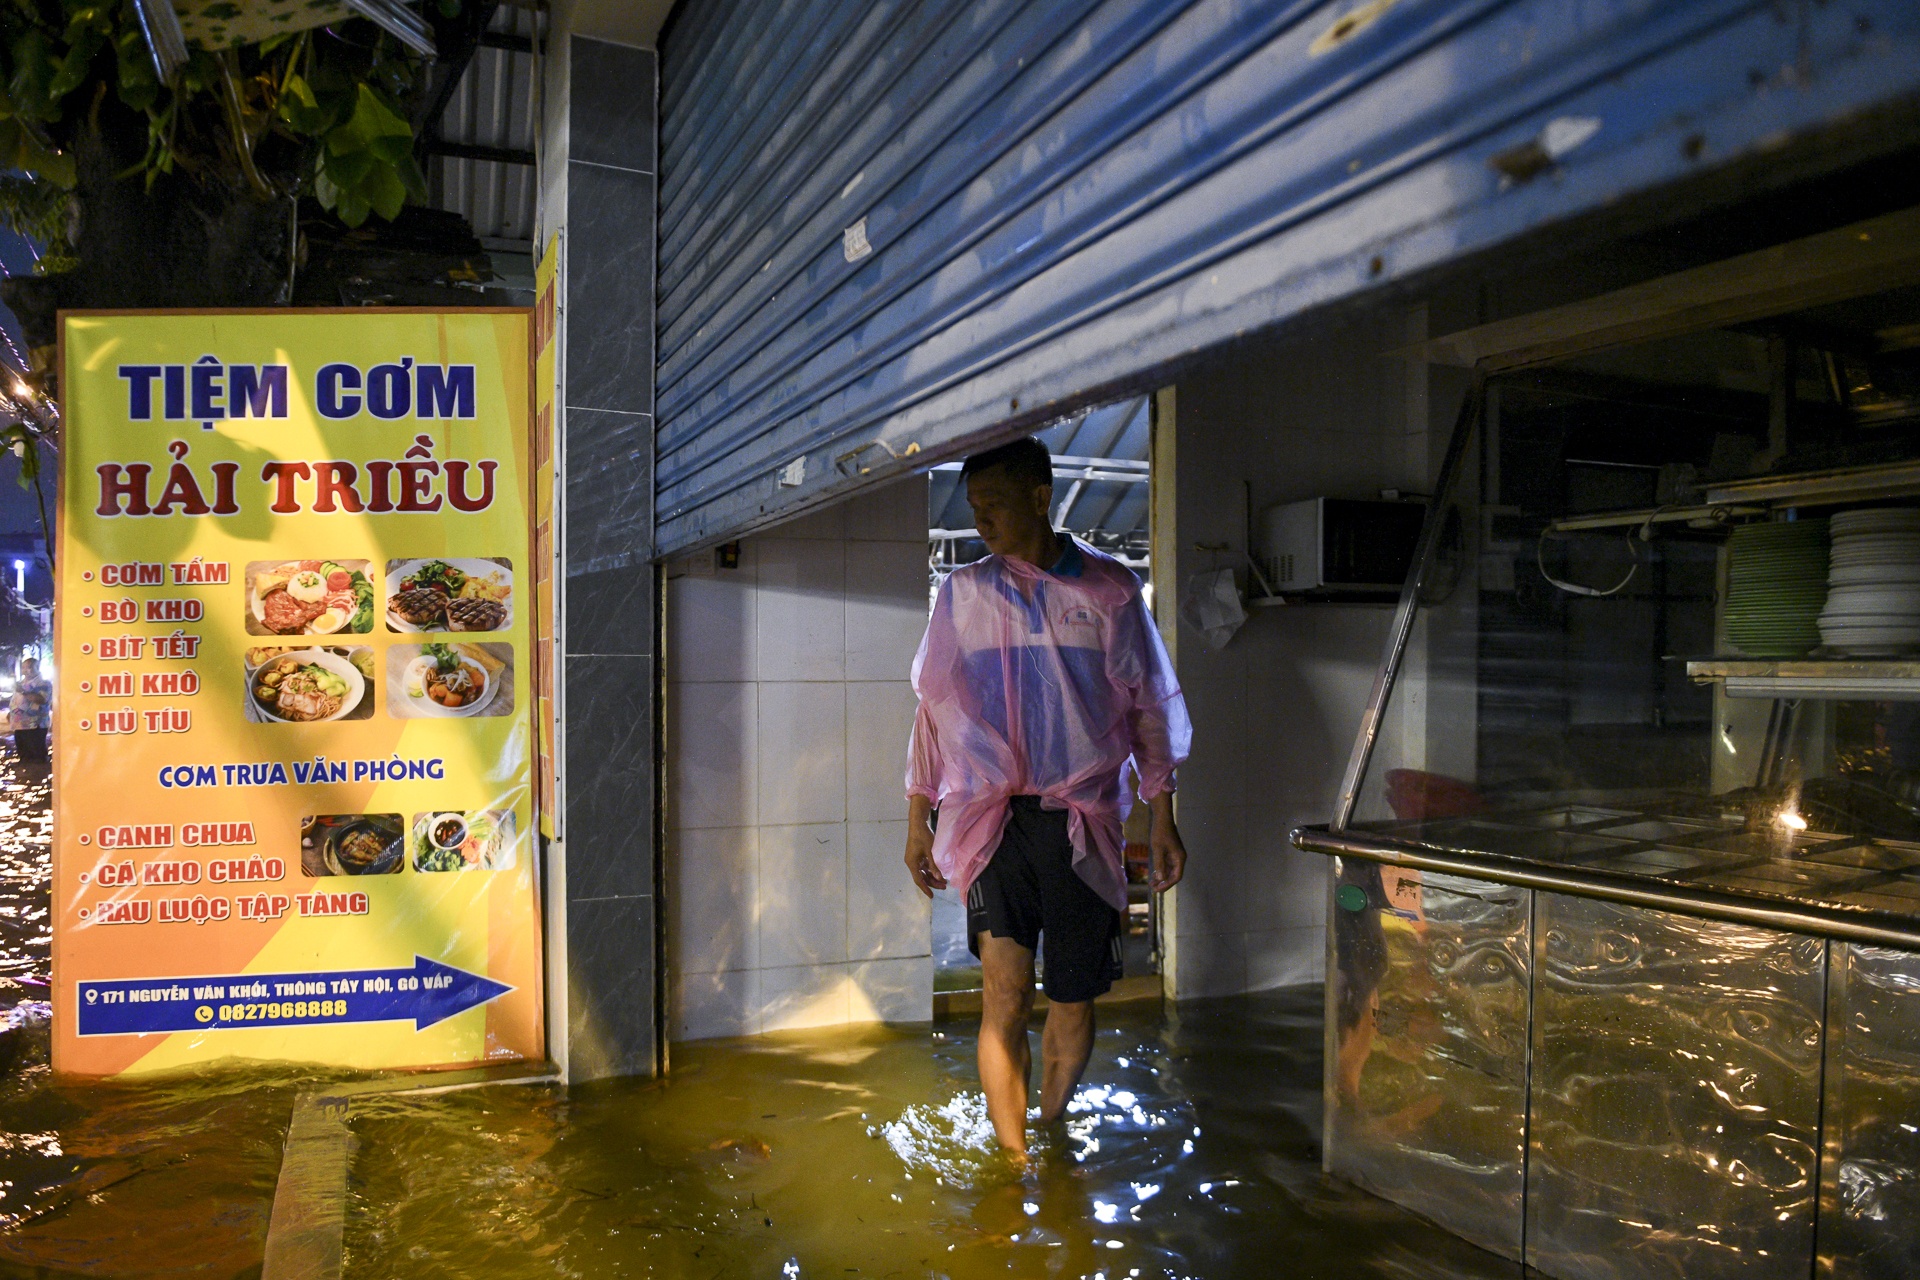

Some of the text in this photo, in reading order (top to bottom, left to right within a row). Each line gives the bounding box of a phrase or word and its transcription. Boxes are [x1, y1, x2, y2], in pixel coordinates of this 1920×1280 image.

[118, 355, 477, 431] TIỆM CƠM
[95, 440, 240, 516] HẢI
[261, 434, 499, 514] TRIỀU
[100, 556, 230, 586] CƠM TẤM
[99, 597, 203, 623] BÒ KHO
[99, 629, 200, 659] BÍT TẾT
[98, 669, 200, 696] MÌ KHÔ
[97, 706, 191, 734] HỦ TÍU
[159, 754, 445, 788] CƠM TRƯA VĂN PHÒNG
[97, 821, 256, 849] CANH CHUA
[97, 854, 285, 887] CÁ KHO CHẢO
[97, 890, 368, 925] RAU LUỘC TẬP TÀNG
[101, 989, 125, 1004] 171
[128, 985, 190, 1003] NGUYỄN
[193, 985, 225, 1000] VĂN
[274, 980, 326, 997] THÔNG
[330, 979, 360, 995] TÂY
[363, 977, 394, 995] HỘI,
[397, 975, 419, 992] GÒ
[422, 972, 454, 990] VẤP
[218, 1000, 348, 1021] 0827968888
